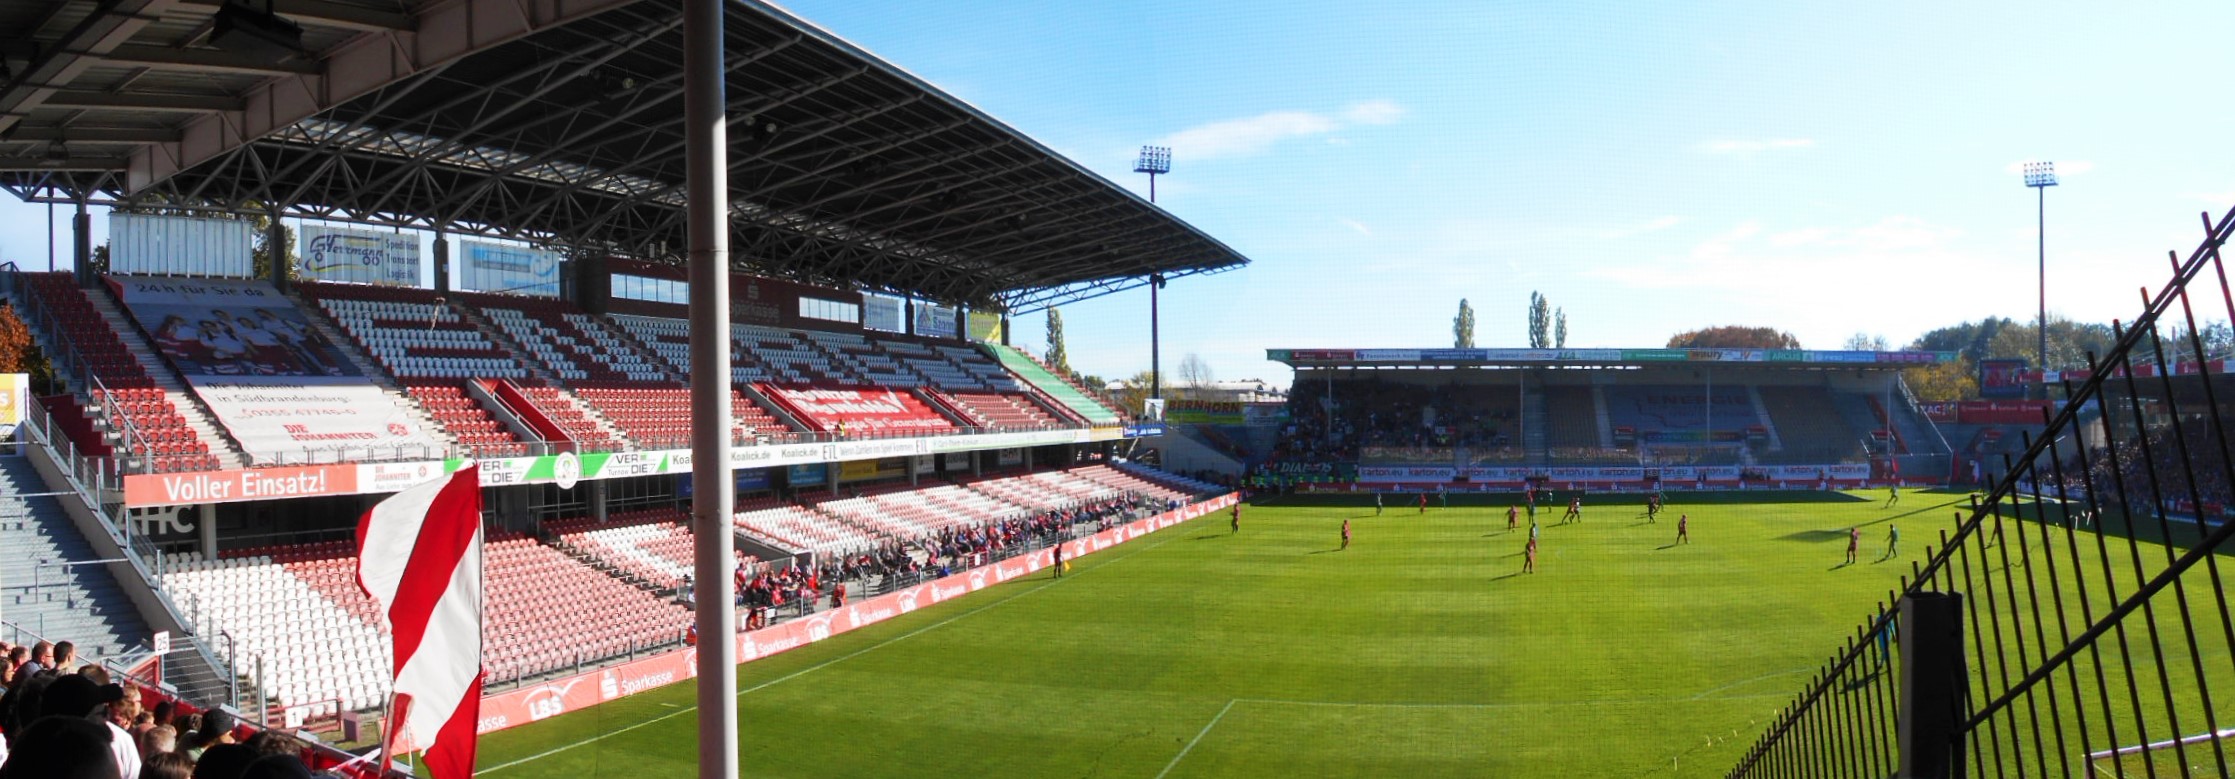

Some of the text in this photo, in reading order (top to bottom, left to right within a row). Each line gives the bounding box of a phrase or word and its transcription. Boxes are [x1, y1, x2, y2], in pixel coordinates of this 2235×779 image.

[244, 287, 265, 298] da
[282, 424, 309, 433] DIE
[289, 431, 377, 442] JOHANNITER
[616, 453, 638, 465] VER
[781, 447, 818, 459] Koalick.de
[631, 463, 648, 475] DIE
[164, 469, 325, 501] Voller Einsatz!
[758, 637, 799, 657] Sparkasse
[621, 670, 673, 695] Sparkasse
[529, 695, 563, 721] LBS
